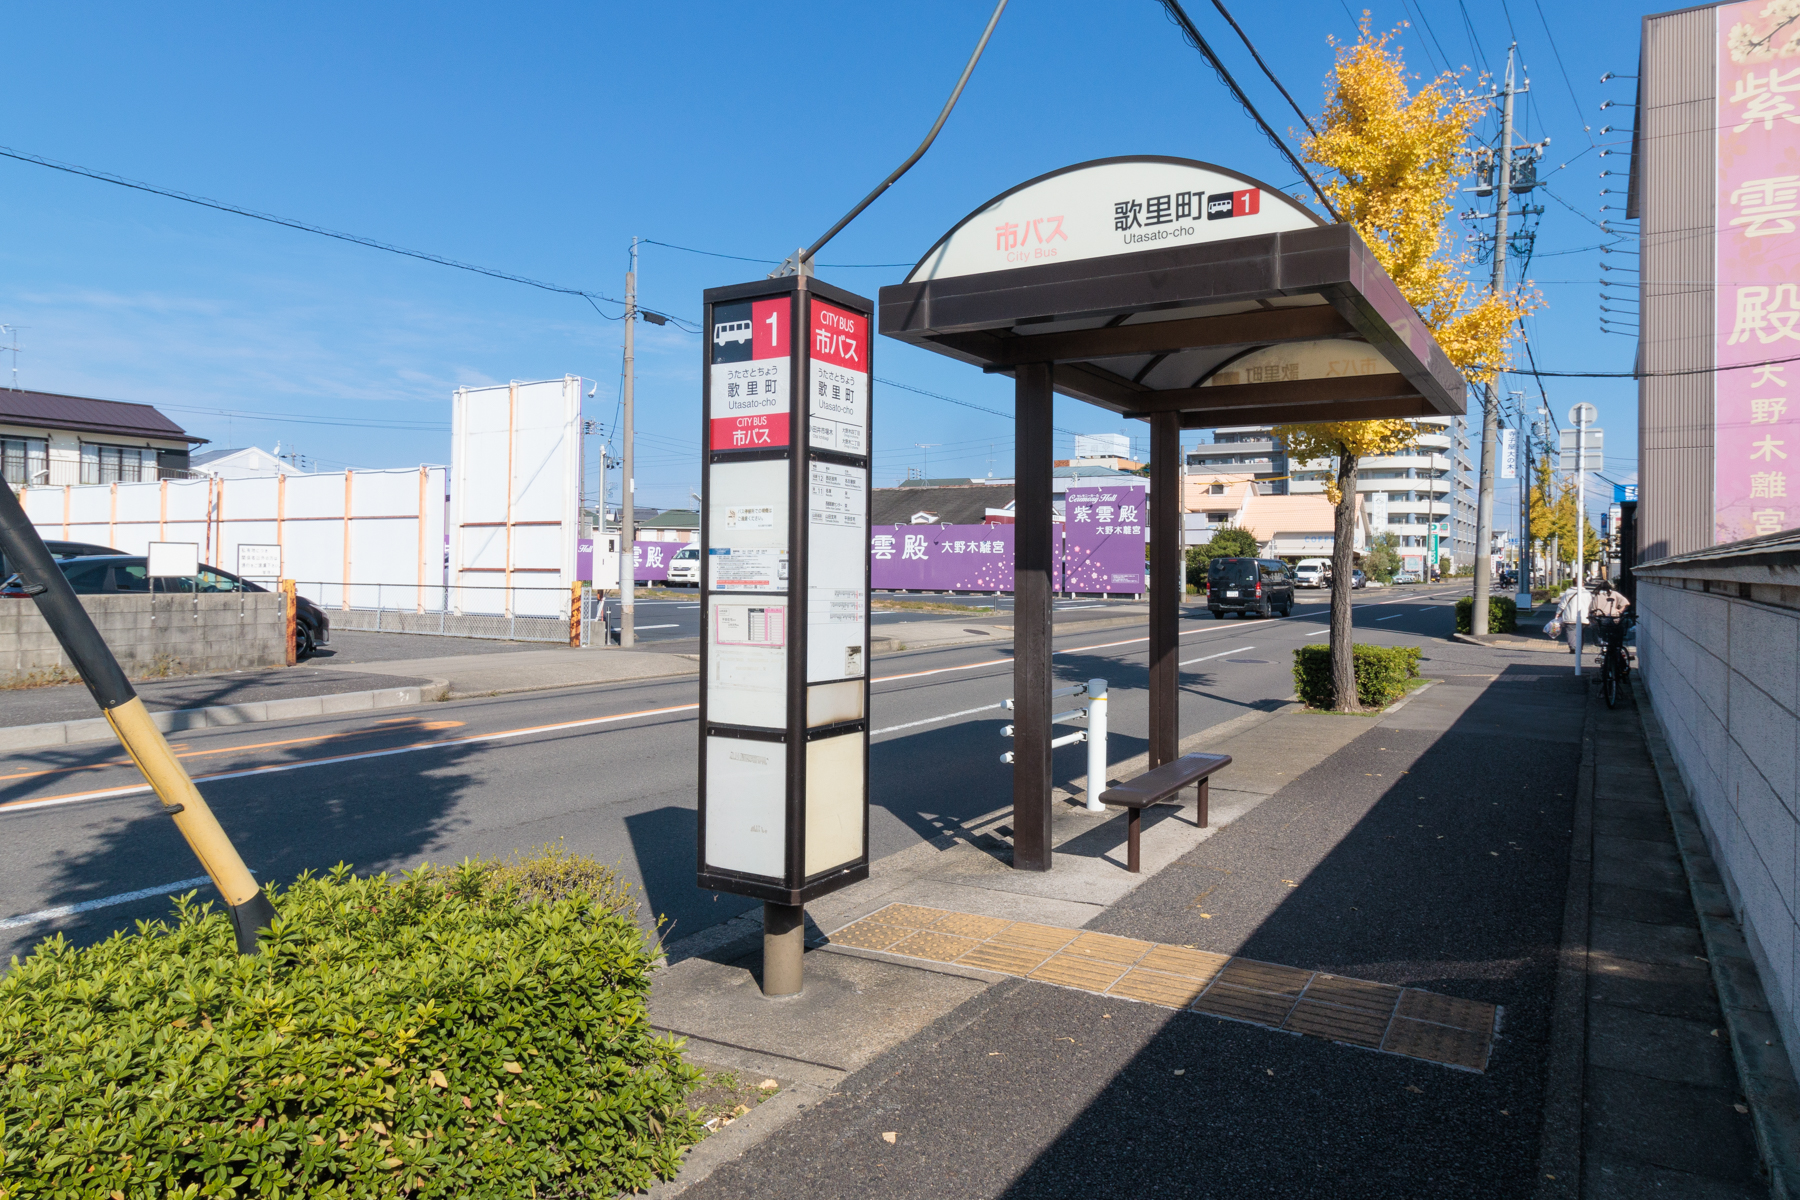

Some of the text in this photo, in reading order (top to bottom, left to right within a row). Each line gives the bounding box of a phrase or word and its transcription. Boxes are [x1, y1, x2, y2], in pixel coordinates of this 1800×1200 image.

[1114, 190, 1205, 231] 歌里町
[1240, 192, 1250, 213] 1
[1728, 67, 1800, 346] 紫雲殿
[995, 214, 1068, 251] 市バス
[1123, 225, 1195, 245] Utasato-cho
[1006, 247, 1058, 262] City Bus
[765, 311, 778, 347] 1
[820, 311, 855, 333] CITY BUS
[815, 328, 859, 362] 市バス
[727, 365, 778, 380] うたさとちょう
[818, 367, 855, 386] うたさとちょう
[727, 379, 777, 398] 歌里町
[818, 380, 854, 404] 歌里町
[728, 398, 777, 410] Utasato-cho
[818, 401, 854, 415] Utasato-cho
[736, 416, 767, 428] CITY BUS
[732, 428, 771, 446] 市バス
[1749, 360, 1788, 536] 大野木離宮
[1099, 493, 1117, 502] Hall
[1074, 505, 1138, 523] 紫雲殿
[1096, 525, 1141, 535] 大野木離宮
[871, 535, 929, 560] 雲殿
[941, 540, 1005, 554] 大野木離宮
